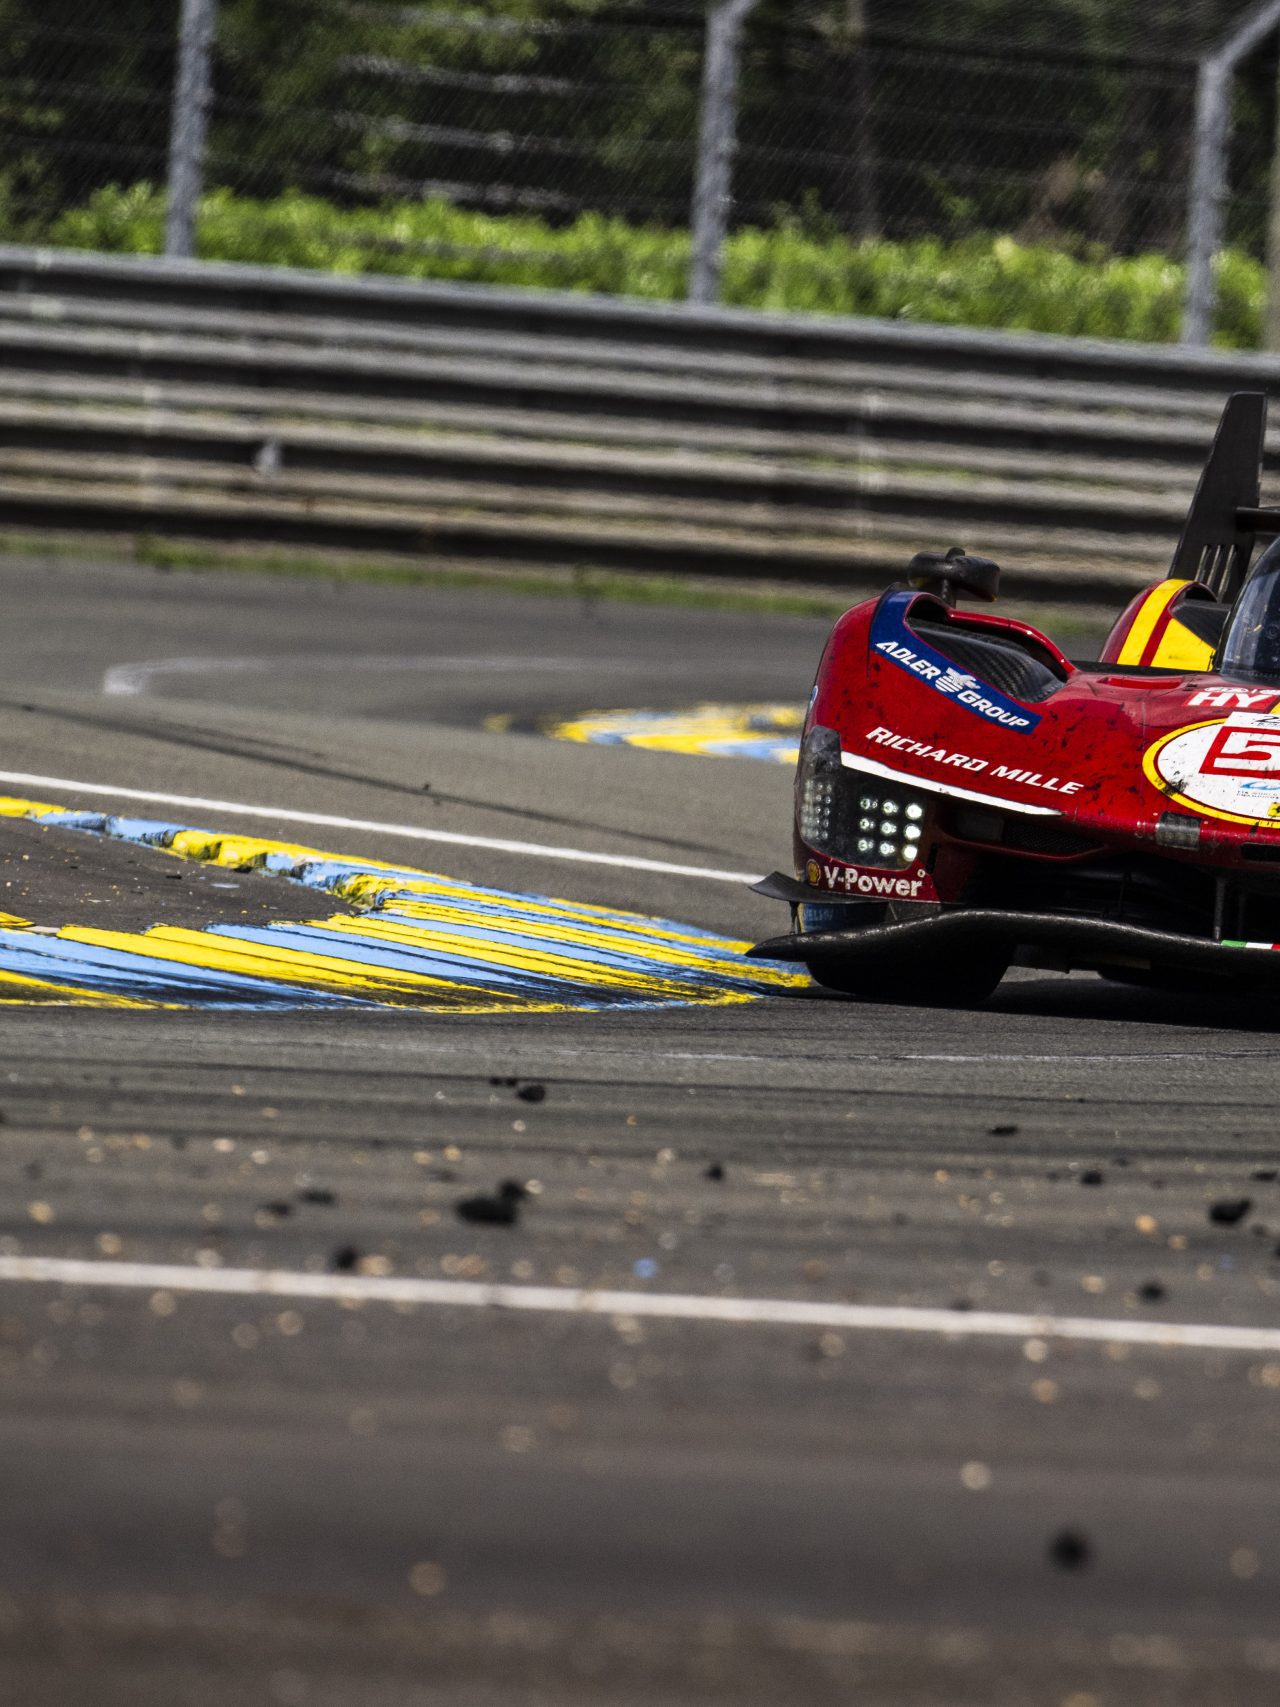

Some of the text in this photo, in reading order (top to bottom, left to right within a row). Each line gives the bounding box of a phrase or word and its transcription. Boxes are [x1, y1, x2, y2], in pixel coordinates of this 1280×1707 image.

[874, 641, 1031, 731] ADLER GROUP
[1187, 691, 1273, 708] HY
[865, 726, 1085, 796] RICHARD MILLE
[824, 866, 922, 897] V-Power
